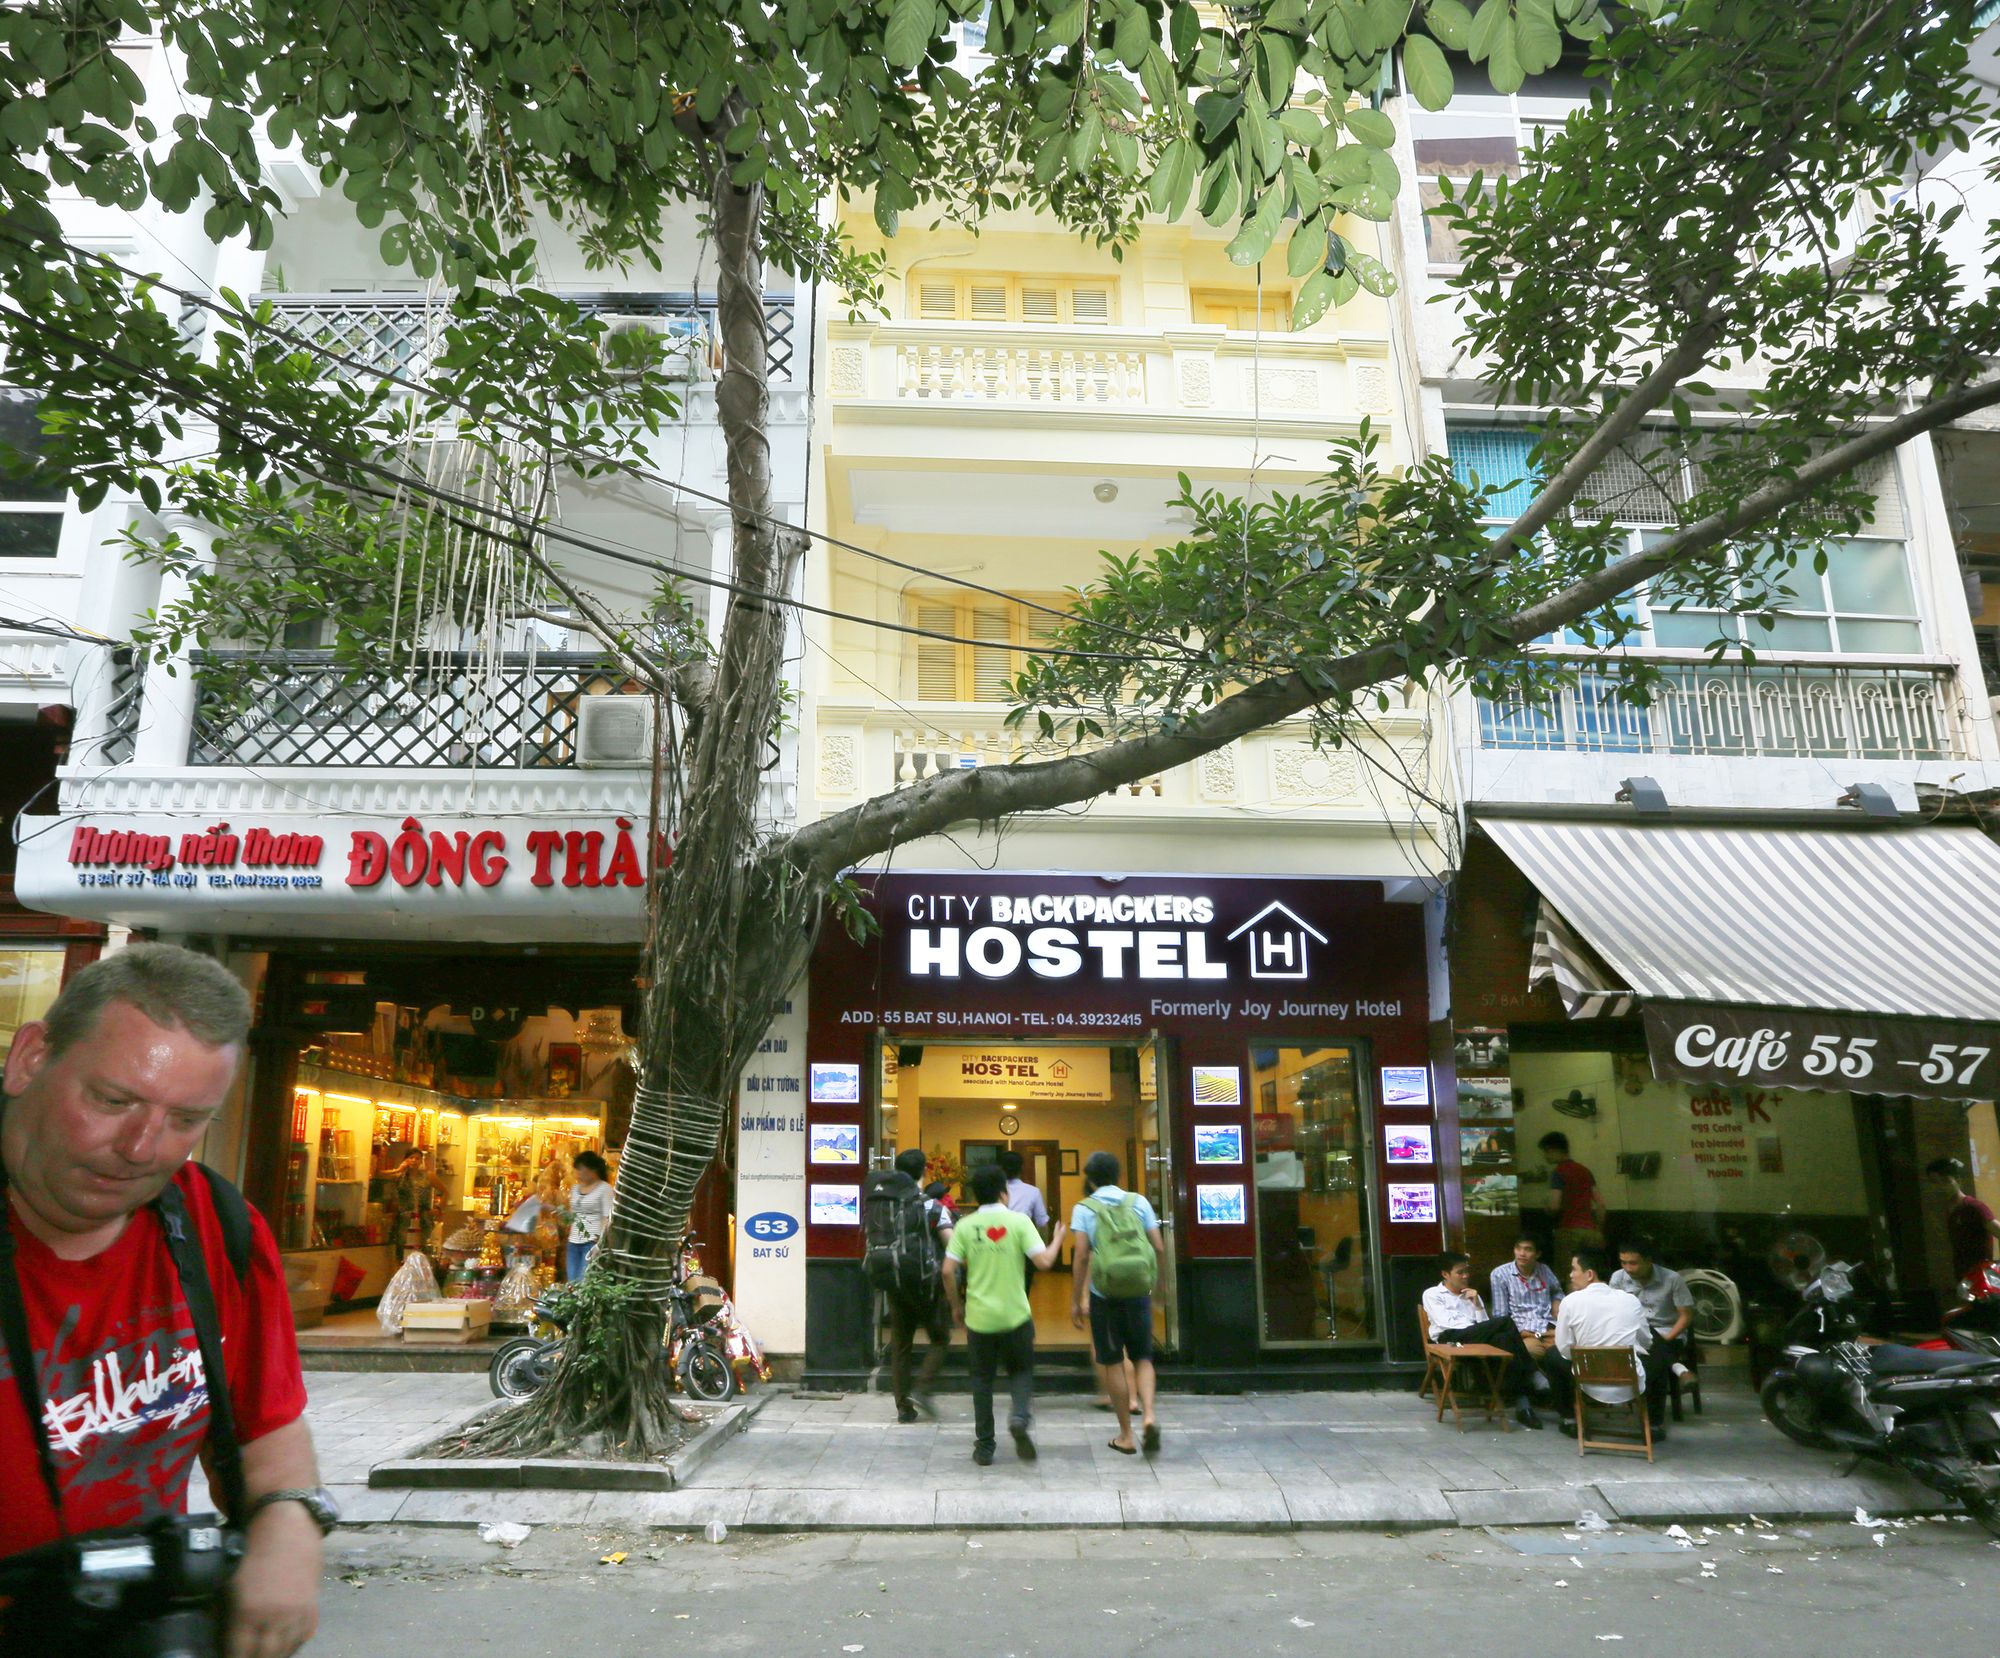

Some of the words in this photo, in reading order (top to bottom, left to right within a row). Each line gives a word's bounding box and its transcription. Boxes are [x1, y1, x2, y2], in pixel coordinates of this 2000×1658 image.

[345, 816, 509, 888] ĐÔNG
[907, 894, 979, 921] CITY
[990, 894, 1215, 925] BACKPACKERS
[908, 926, 1229, 980] HOSTEL
[883, 1011, 901, 1023] 55
[904, 1012, 933, 1024] BAT
[1150, 999, 1232, 1020] Formerly
[1239, 999, 1272, 1020] Joy
[1278, 999, 1349, 1021] Journey
[1355, 999, 1402, 1017] Hotel
[981, 1054, 1039, 1064] BACKPACKERS
[1674, 1024, 1792, 1077] Café
[1802, 1034, 1878, 1079] 55
[754, 1219, 789, 1235] 53
